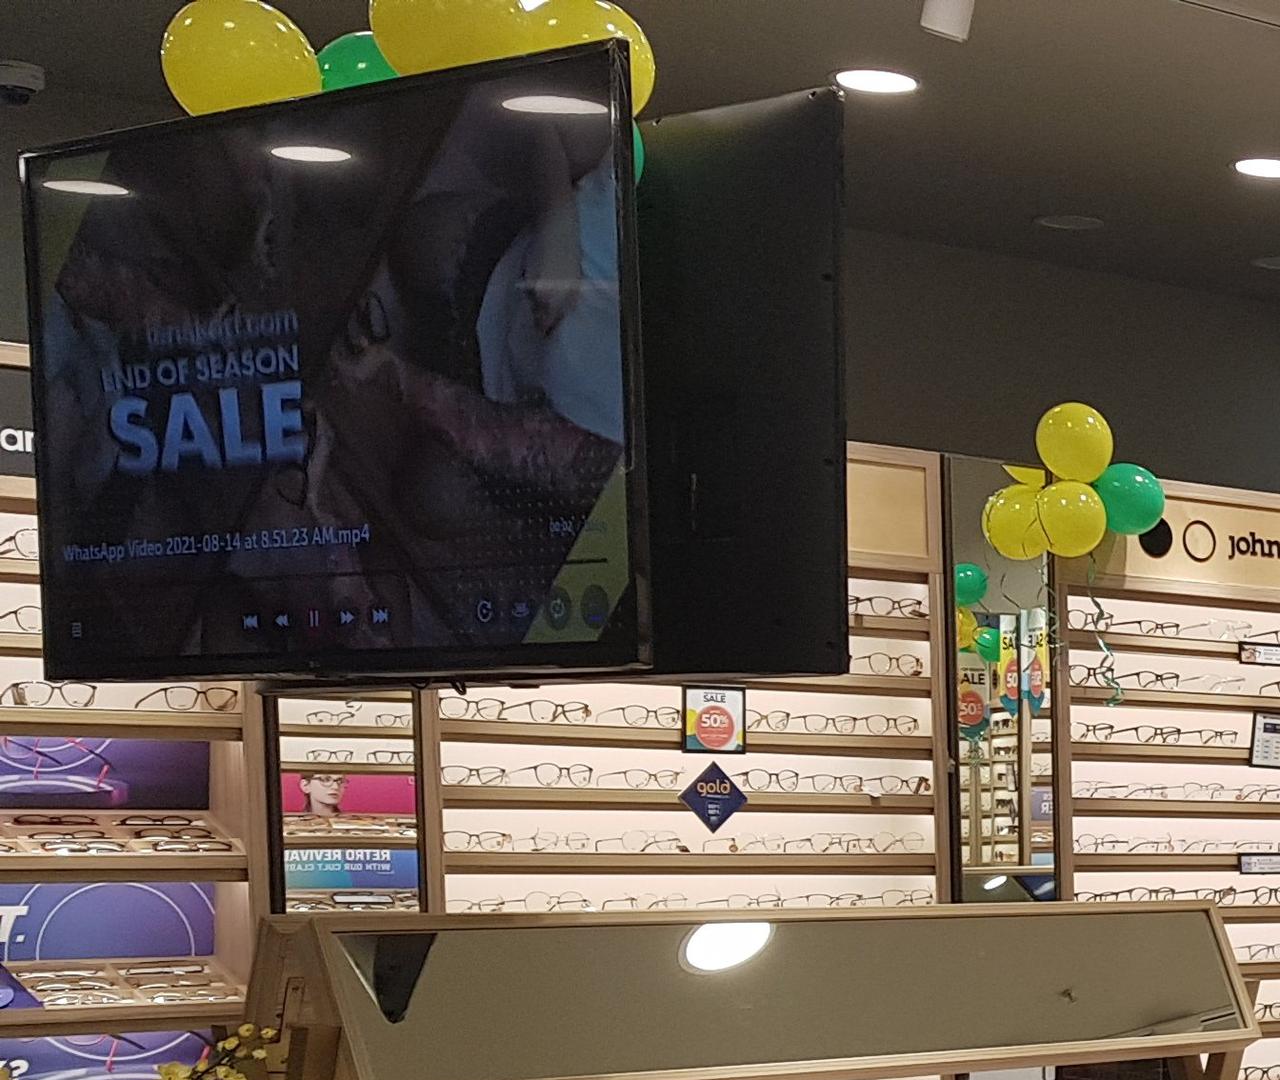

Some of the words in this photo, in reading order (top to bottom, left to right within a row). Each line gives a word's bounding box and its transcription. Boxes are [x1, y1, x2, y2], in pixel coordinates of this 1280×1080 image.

[101, 364, 150, 393] END
[157, 359, 189, 386] OF
[197, 345, 299, 381] SEASON
[110, 379, 306, 476] SALE
[63, 543, 124, 563] WhatsApp
[128, 539, 161, 557] Video
[166, 532, 241, 556] 2021-08-14
[244, 533, 258, 550] at
[261, 527, 308, 549] 8.51.23
[312, 524, 370, 547] AM.mp4
[960, 671, 986, 686] ALE
[703, 694, 726, 704] SALE
[697, 778, 731, 797] gold
